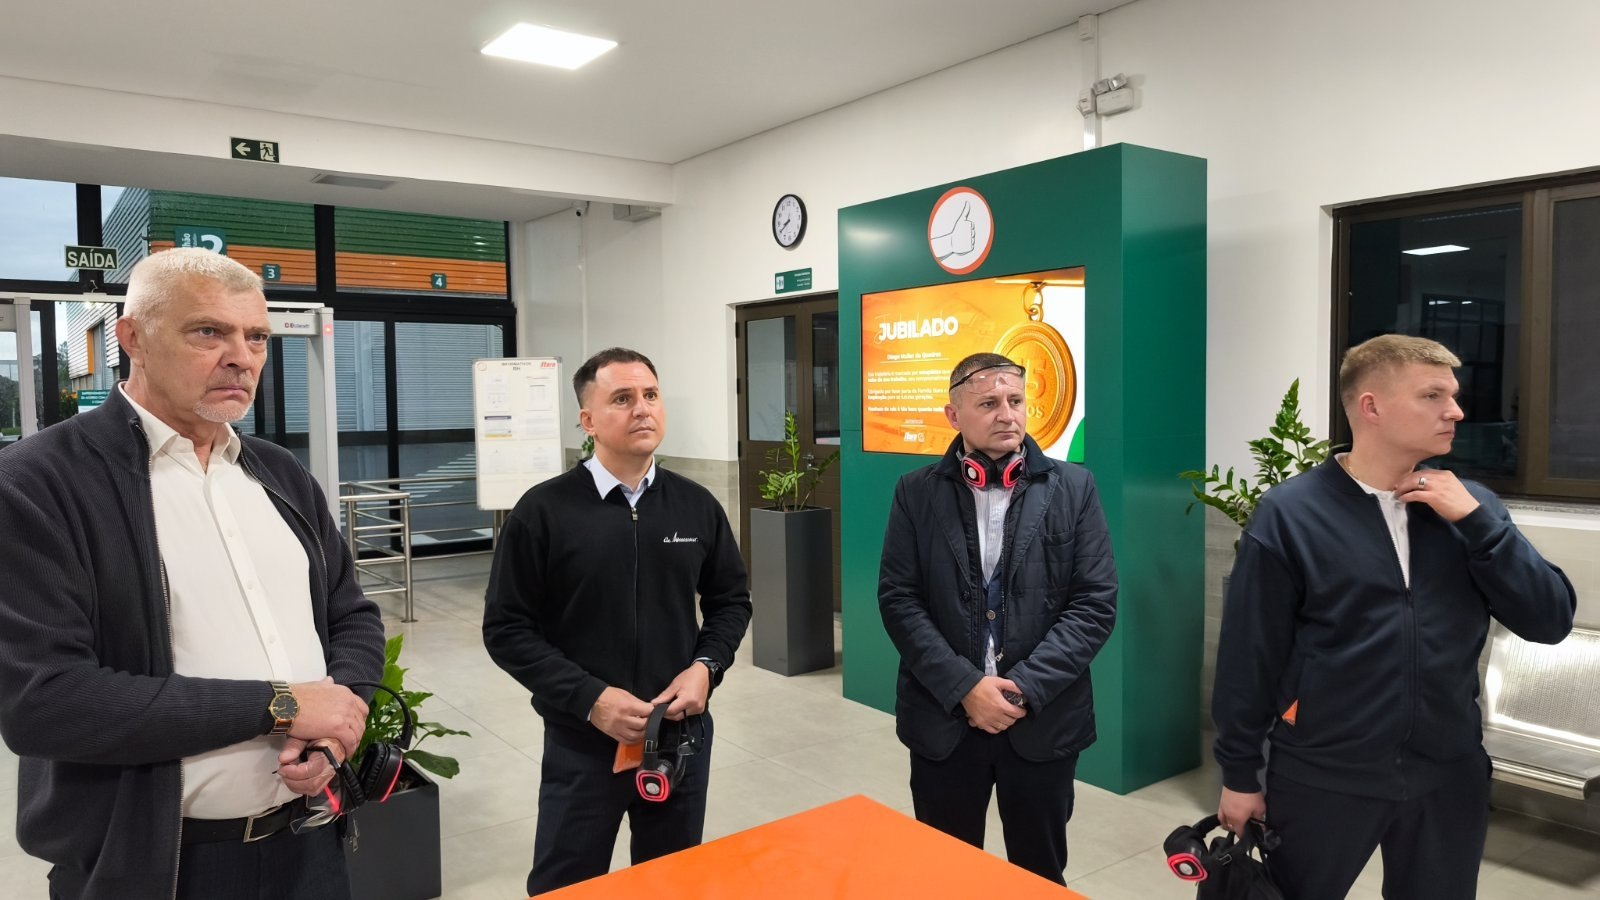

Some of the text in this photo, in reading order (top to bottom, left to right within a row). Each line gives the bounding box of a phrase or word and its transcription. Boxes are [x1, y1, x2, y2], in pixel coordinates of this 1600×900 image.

[67, 248, 116, 268] SAÍDA
[267, 269, 275, 278] 3
[435, 277, 442, 286] 4
[879, 316, 959, 341] JUBILADO
